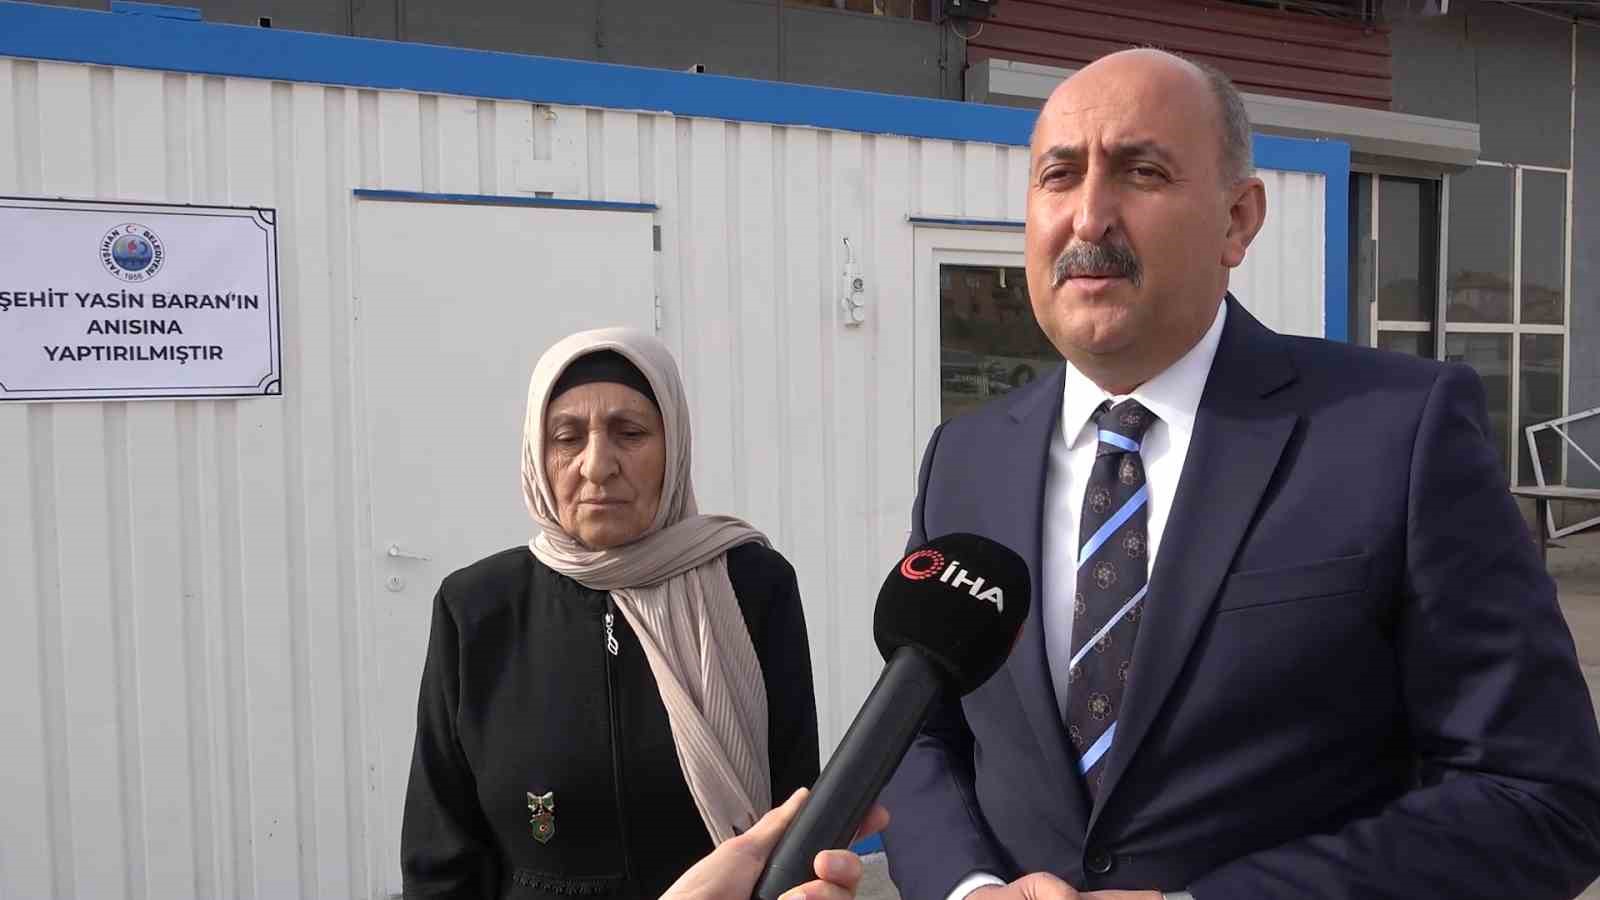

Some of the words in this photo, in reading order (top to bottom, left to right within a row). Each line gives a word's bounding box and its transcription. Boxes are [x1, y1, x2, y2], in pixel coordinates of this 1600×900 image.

[143, 230, 162, 276] BELEDİYESİ
[0, 288, 68, 311] ŞEHİT
[76, 289, 144, 309] YASİN
[152, 293, 259, 309] BARAN'IN
[86, 319, 183, 335] ANISINA
[44, 345, 223, 364] YAPTIRILMIŞTIR
[939, 560, 1004, 614] İHA
